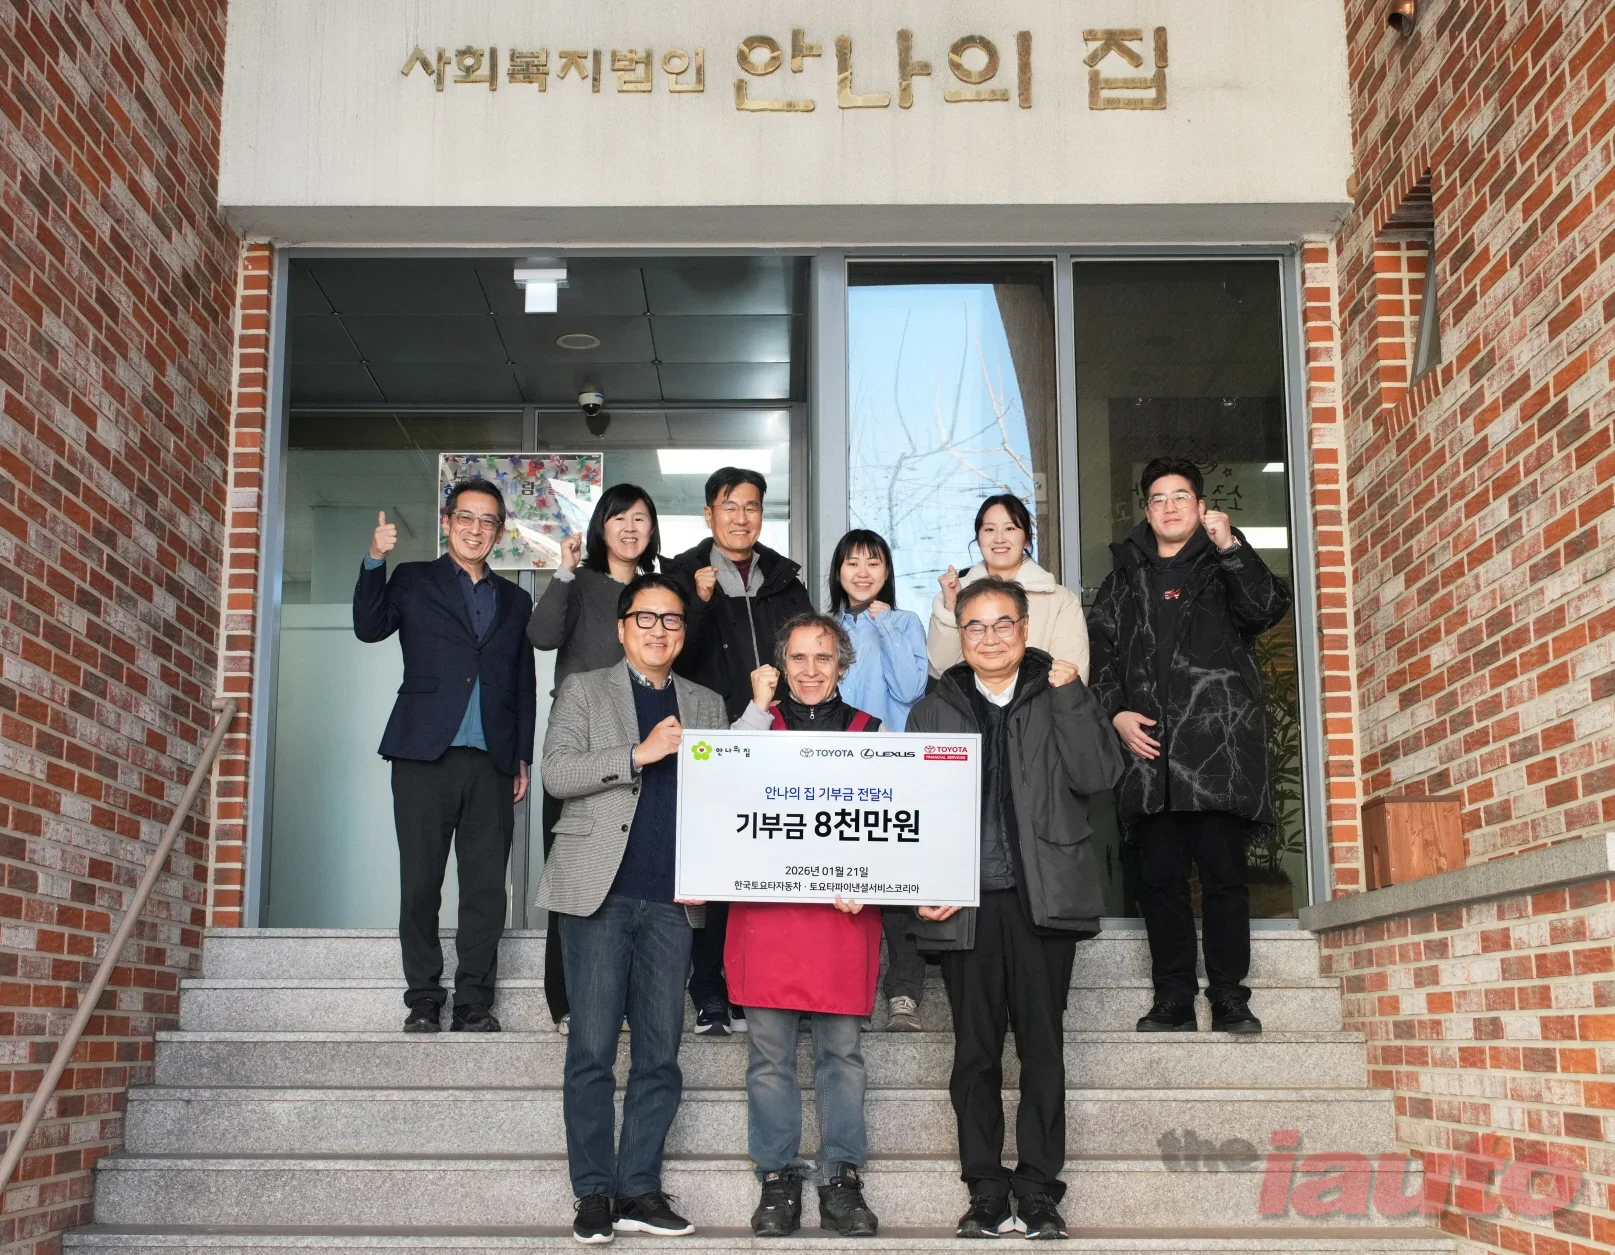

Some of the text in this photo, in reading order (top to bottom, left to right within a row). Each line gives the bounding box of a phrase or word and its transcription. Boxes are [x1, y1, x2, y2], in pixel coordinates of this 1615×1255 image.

[401, 26, 1168, 112] 사회복지법인 안나의 집
[716, 745, 750, 757] 안나의 집
[815, 749, 854, 757] TOYOTA
[765, 786, 893, 802] 안나의 집 기부금 전달식
[736, 808, 920, 843] 기부금 8천만원
[785, 866, 868, 878] 2026년 01월 21일
[734, 881, 920, 894] 한국토요타자동차 토요타파이낸셜서비스코리아
